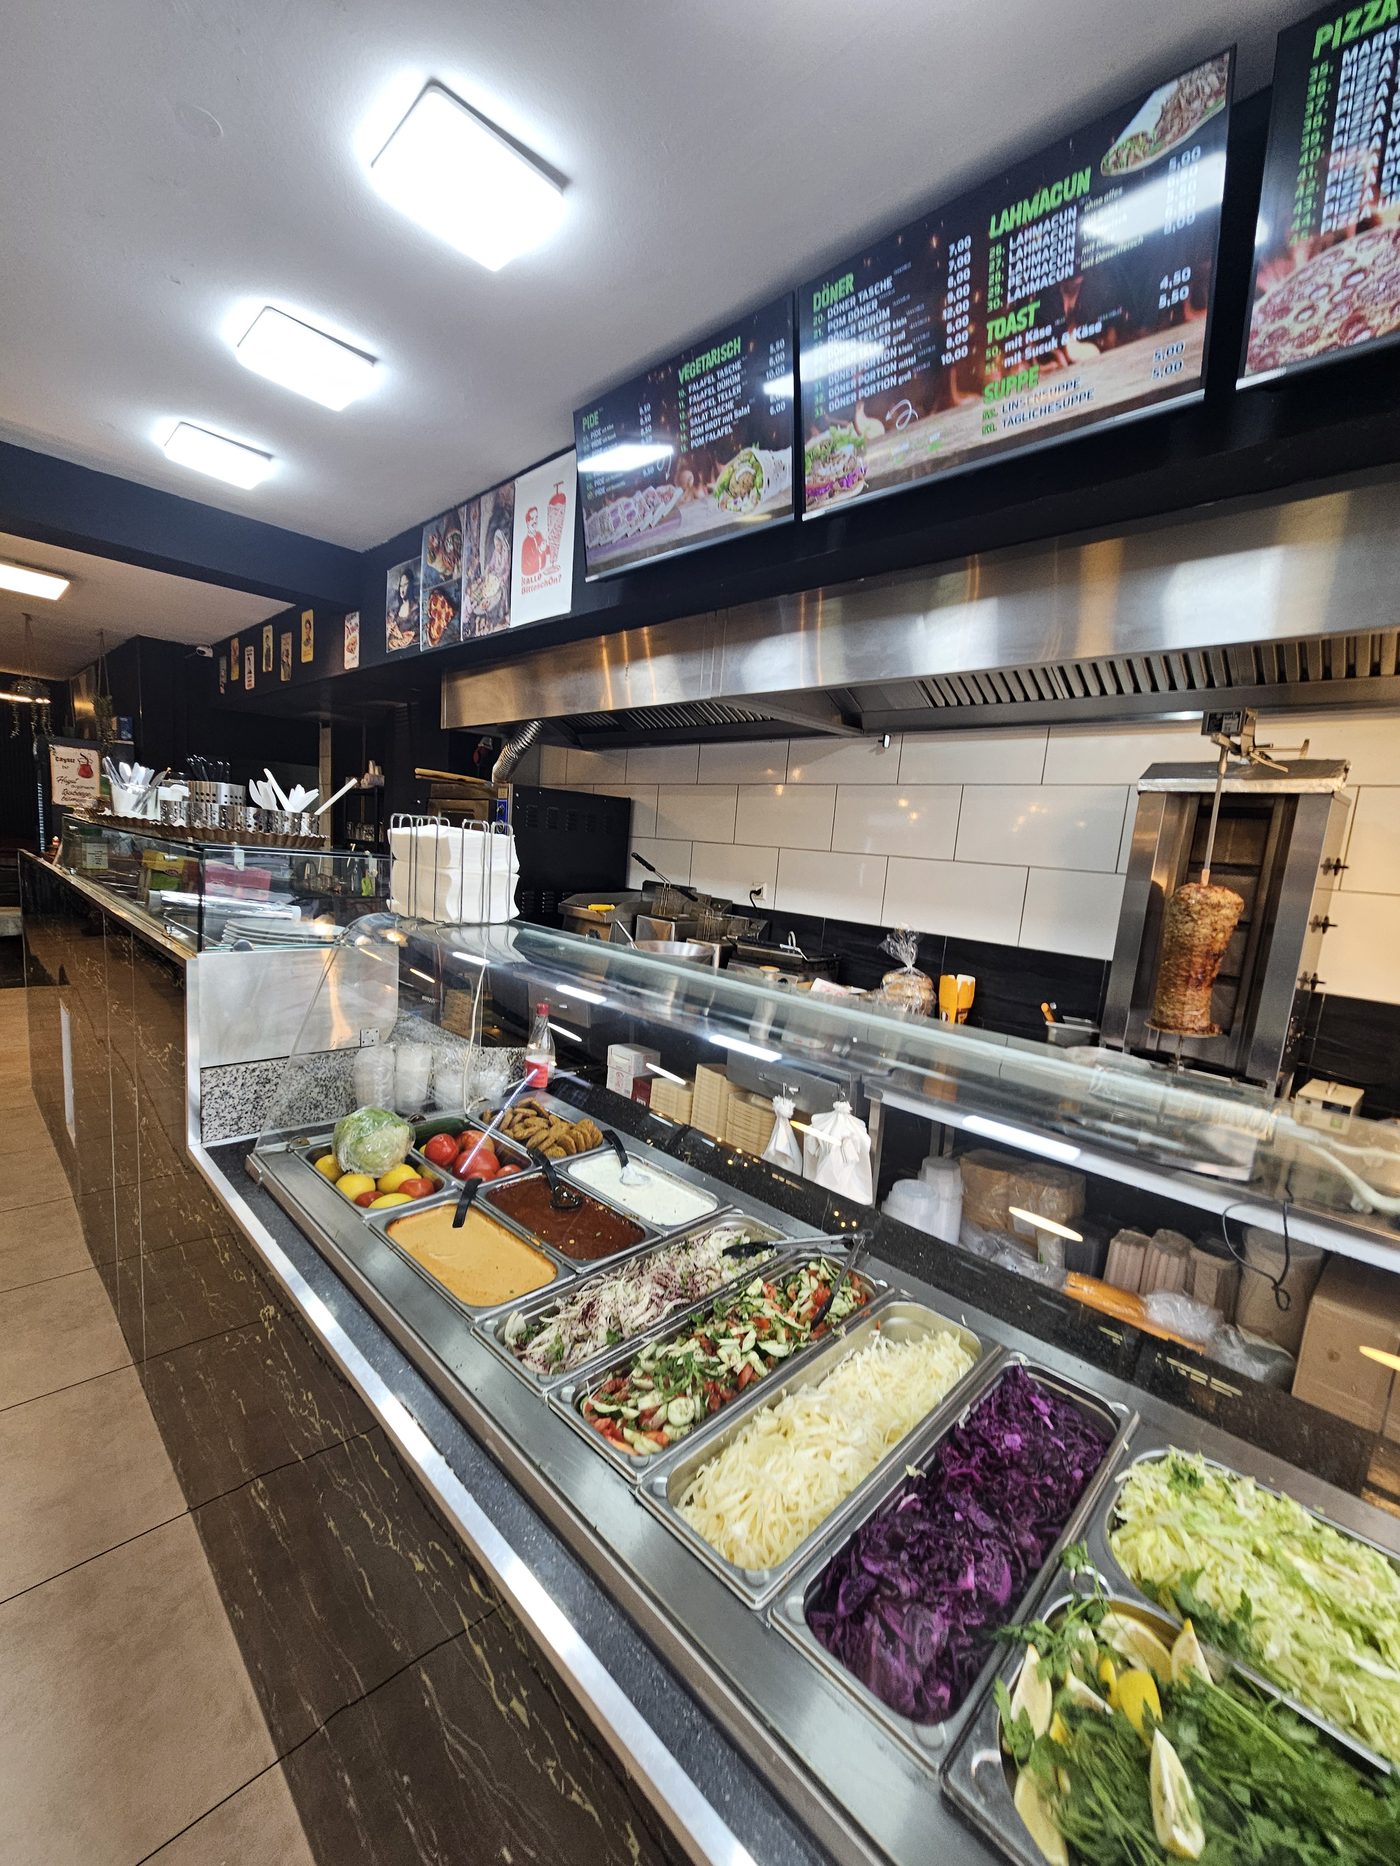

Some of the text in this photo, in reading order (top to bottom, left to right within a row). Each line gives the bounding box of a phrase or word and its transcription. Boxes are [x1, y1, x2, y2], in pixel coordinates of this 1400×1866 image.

[1313, 0, 1398, 59] PIZZA
[989, 166, 1092, 239] LAHMACUN
[1009, 221, 1077, 264] LAHMACUN
[1010, 204, 1077, 250] LAHMACUN
[1008, 235, 1075, 277] LAHMACUN
[812, 271, 855, 313] DÖNER
[827, 294, 857, 320] DÖNER
[858, 274, 894, 303] TASCHE
[1007, 262, 1074, 304] LAHMACUN
[827, 315, 847, 333] POM
[847, 298, 878, 324] DÖNER
[827, 322, 857, 344] DÖNER
[858, 306, 891, 332] DÜRÜM
[986, 299, 1041, 344] TOAST
[1004, 335, 1023, 353] mit
[1025, 324, 1053, 344] Käse
[1004, 350, 1022, 369] mit
[1072, 320, 1103, 341] Käse
[678, 335, 741, 385] VEGETARISCH
[688, 373, 716, 394] FALAFEL
[716, 359, 742, 377] TASCHE
[828, 364, 857, 386] DÖNER
[858, 345, 897, 374] PORTION
[828, 378, 857, 399] DÖNER
[858, 360, 897, 387] PORTION
[689, 385, 716, 406] FALAFEL
[828, 393, 857, 413] DÖNER
[858, 375, 897, 401] PORTION
[983, 363, 1040, 405] SUPPE
[1002, 376, 1081, 414] LINSENSUPPE
[582, 409, 600, 433] PIDE
[689, 397, 716, 417] FALAFEL
[690, 425, 705, 439] POM
[690, 436, 705, 450] POM
[705, 423, 733, 444] FALAFEL
